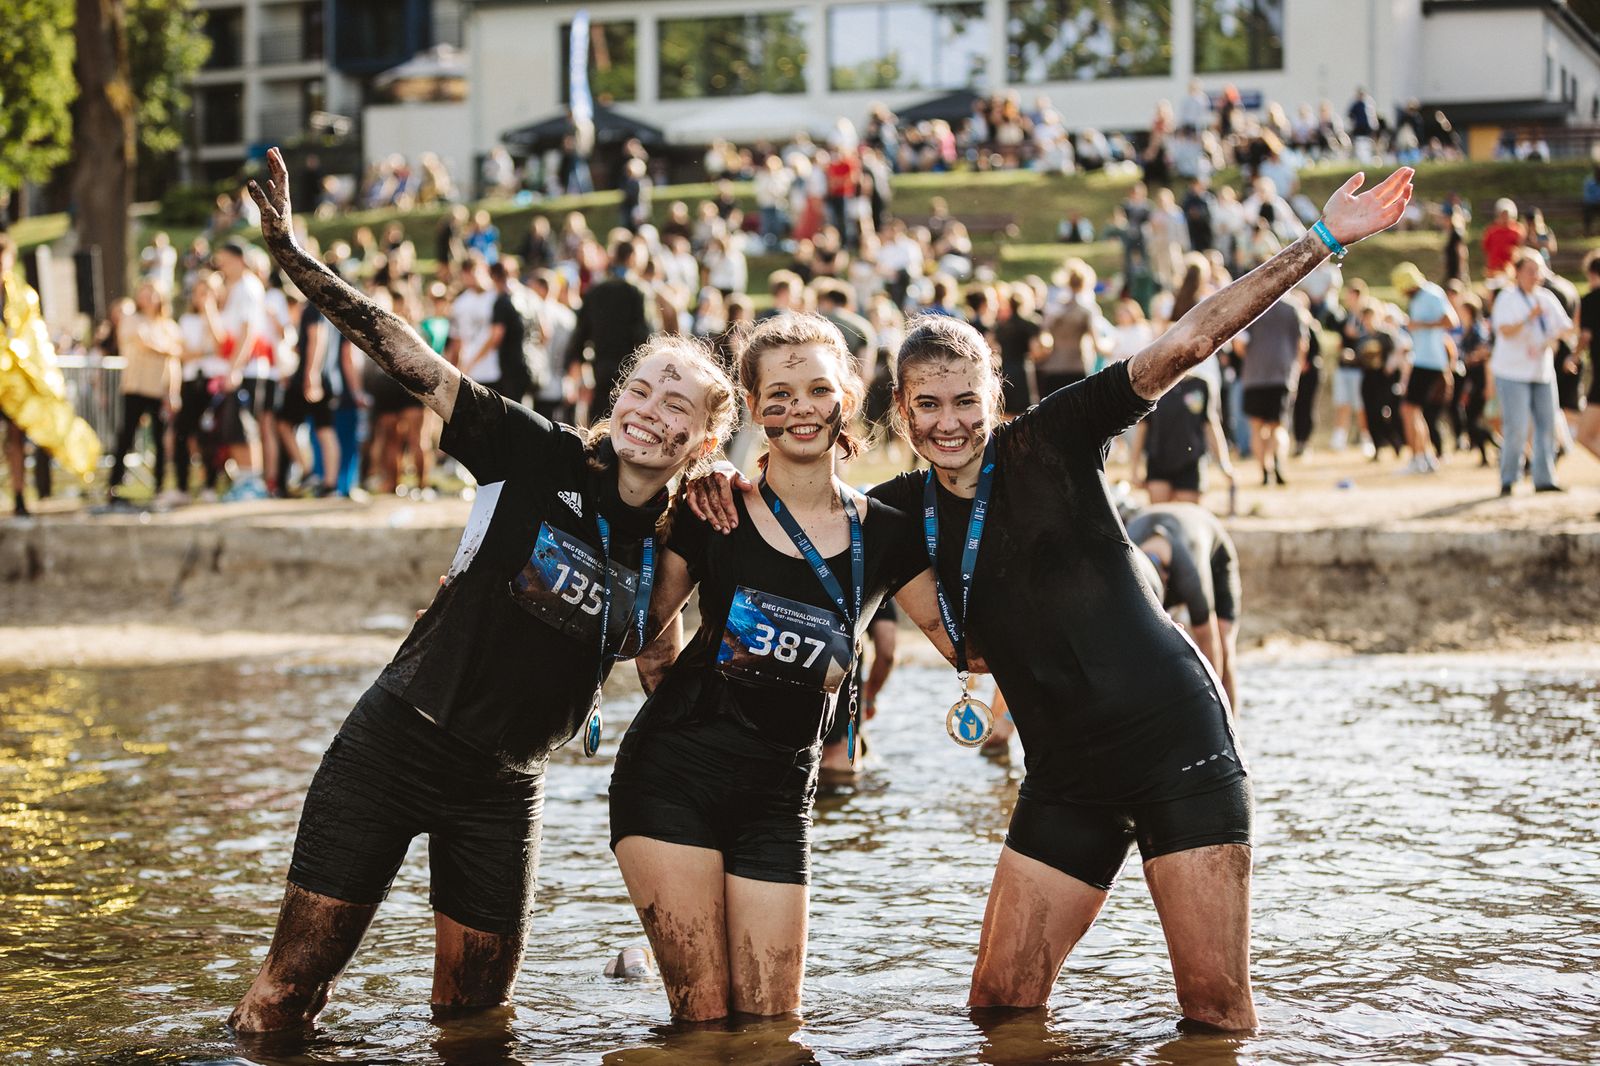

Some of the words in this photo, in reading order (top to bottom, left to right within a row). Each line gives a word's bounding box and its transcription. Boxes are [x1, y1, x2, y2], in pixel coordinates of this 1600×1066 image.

[558, 490, 583, 518] adidas
[562, 541, 576, 552] BIEG
[551, 563, 605, 616] 135
[761, 602, 777, 612] BIEG
[776, 606, 831, 627] FESTIWALOWICZA
[938, 592, 953, 623] Festiwal
[748, 623, 826, 668] 387
